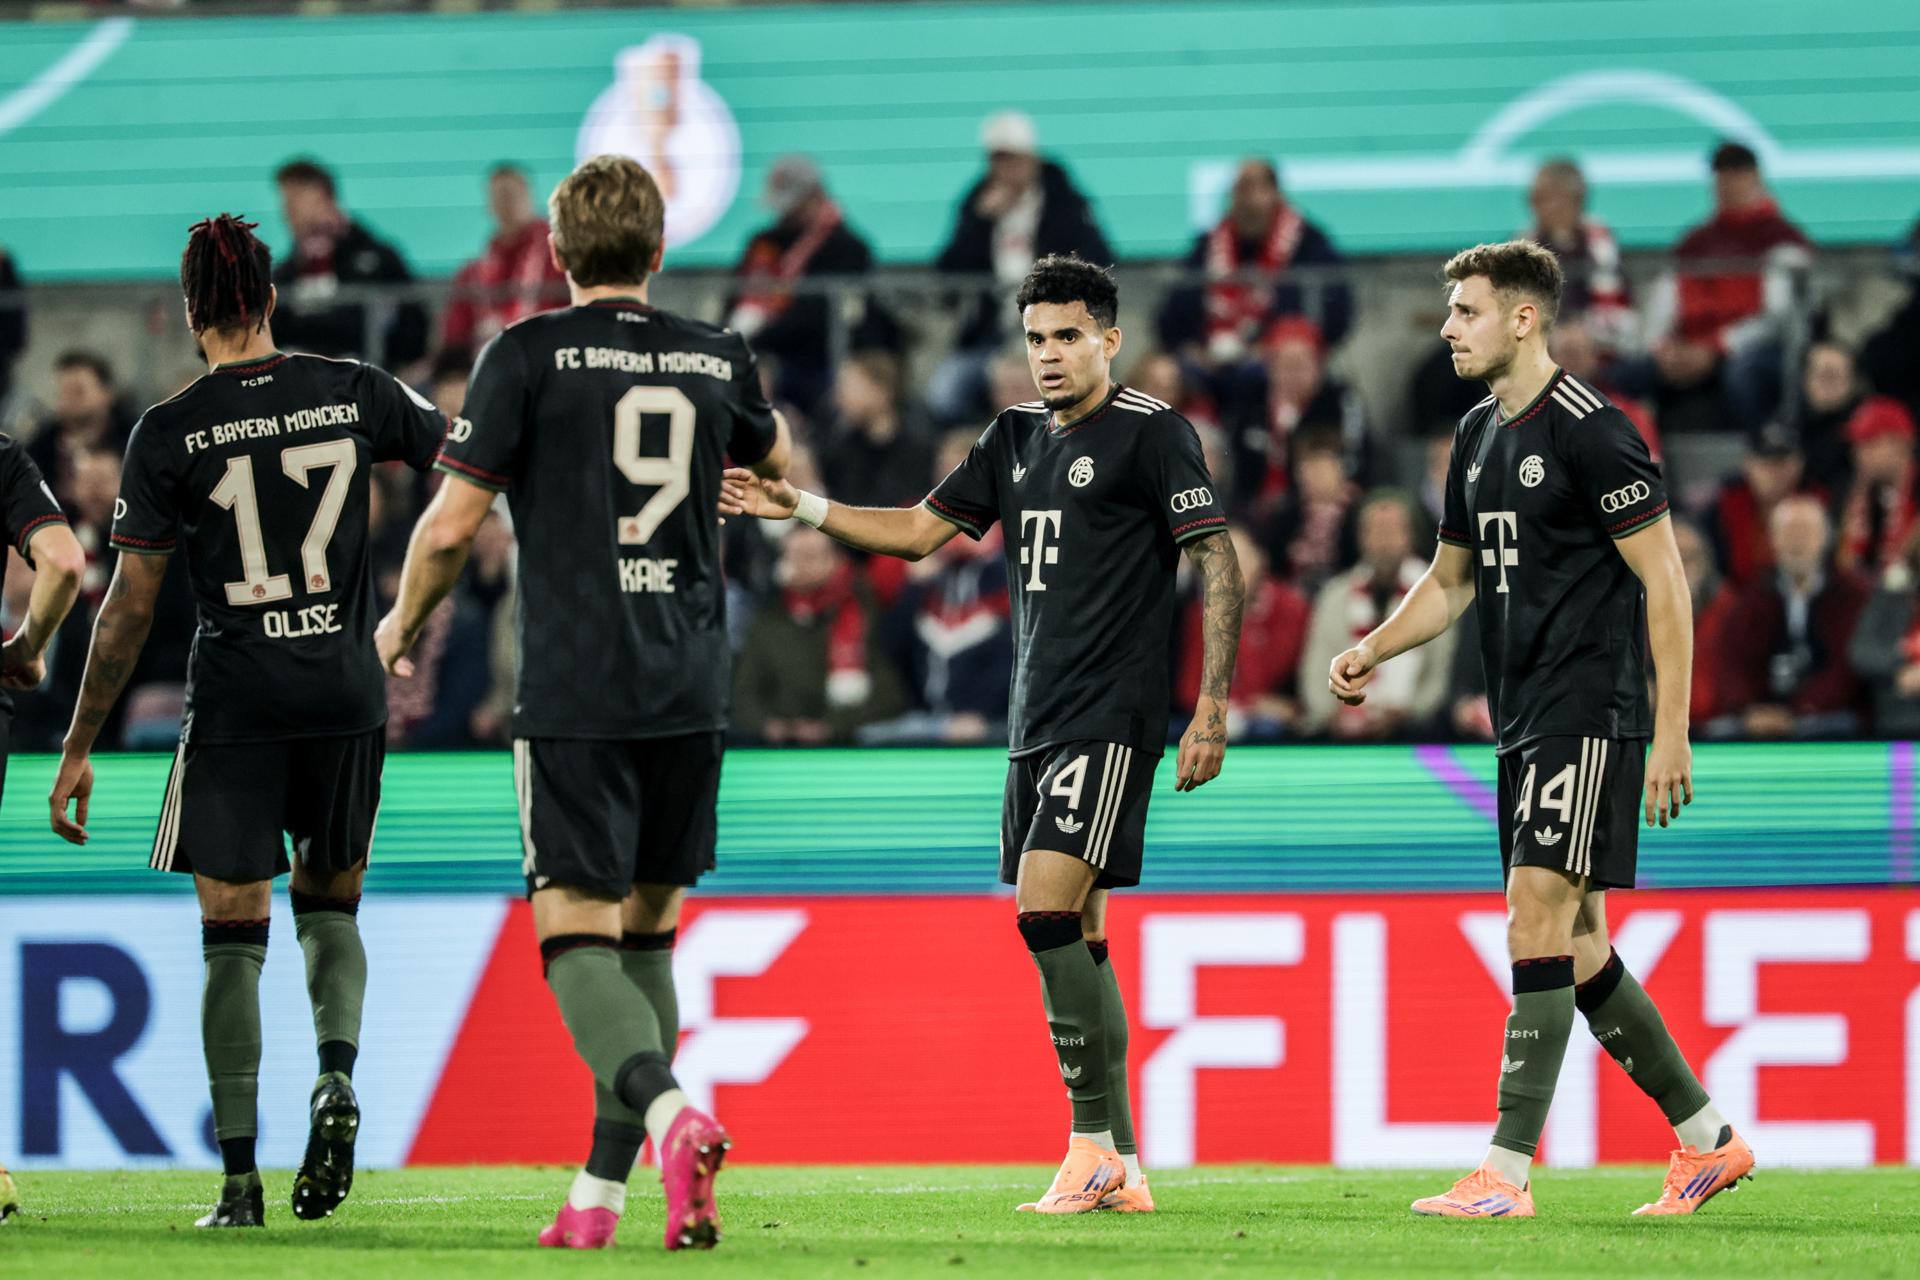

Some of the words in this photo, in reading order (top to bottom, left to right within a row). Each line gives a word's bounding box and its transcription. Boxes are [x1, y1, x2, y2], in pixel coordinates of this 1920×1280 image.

[555, 347, 581, 370] FC
[584, 347, 653, 373] BAYERN
[241, 374, 274, 387] FCBM
[184, 431, 209, 454] FC
[212, 416, 280, 445] BAYERN
[612, 385, 696, 545] 9
[208, 437, 357, 606] 17
[1020, 510, 1062, 592] T
[1477, 511, 1519, 593] T
[618, 558, 678, 593] KANE
[263, 603, 342, 638] OLISE
[1140, 908, 1920, 1167] FLYE
[1054, 1193, 1098, 1206] F50
